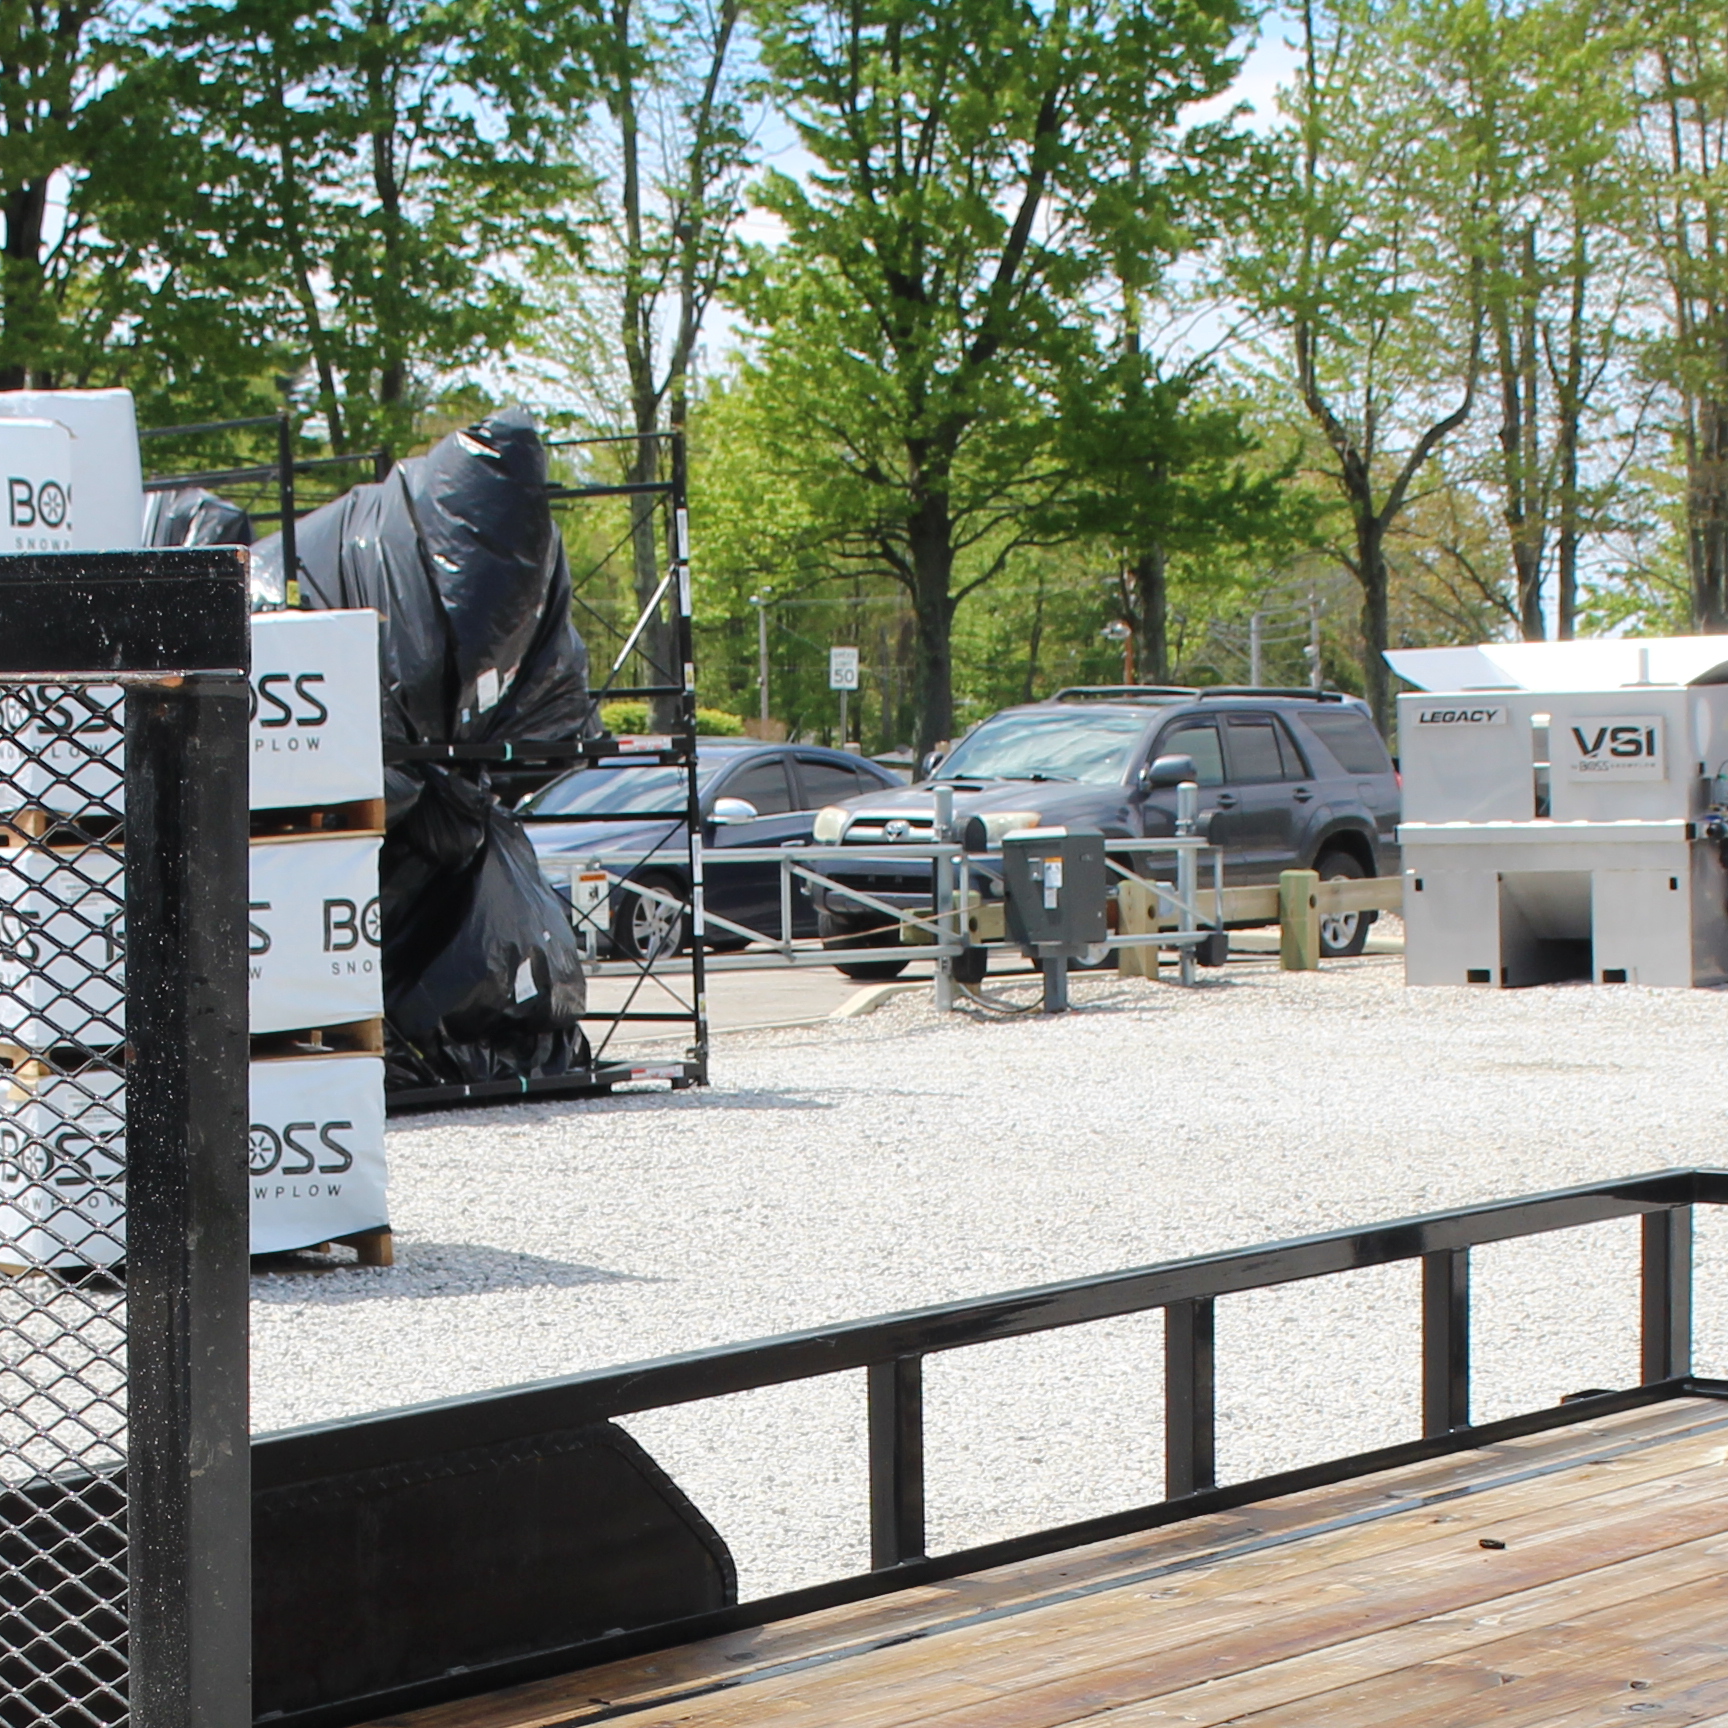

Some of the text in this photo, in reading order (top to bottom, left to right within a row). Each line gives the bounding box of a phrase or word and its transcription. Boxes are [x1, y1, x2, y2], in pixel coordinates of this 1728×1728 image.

[7, 476, 71, 530] BO
[834, 669, 854, 684] 50
[249, 673, 328, 728] SS
[1419, 709, 1498, 724] LEGACY
[332, 959, 382, 976] SNO
